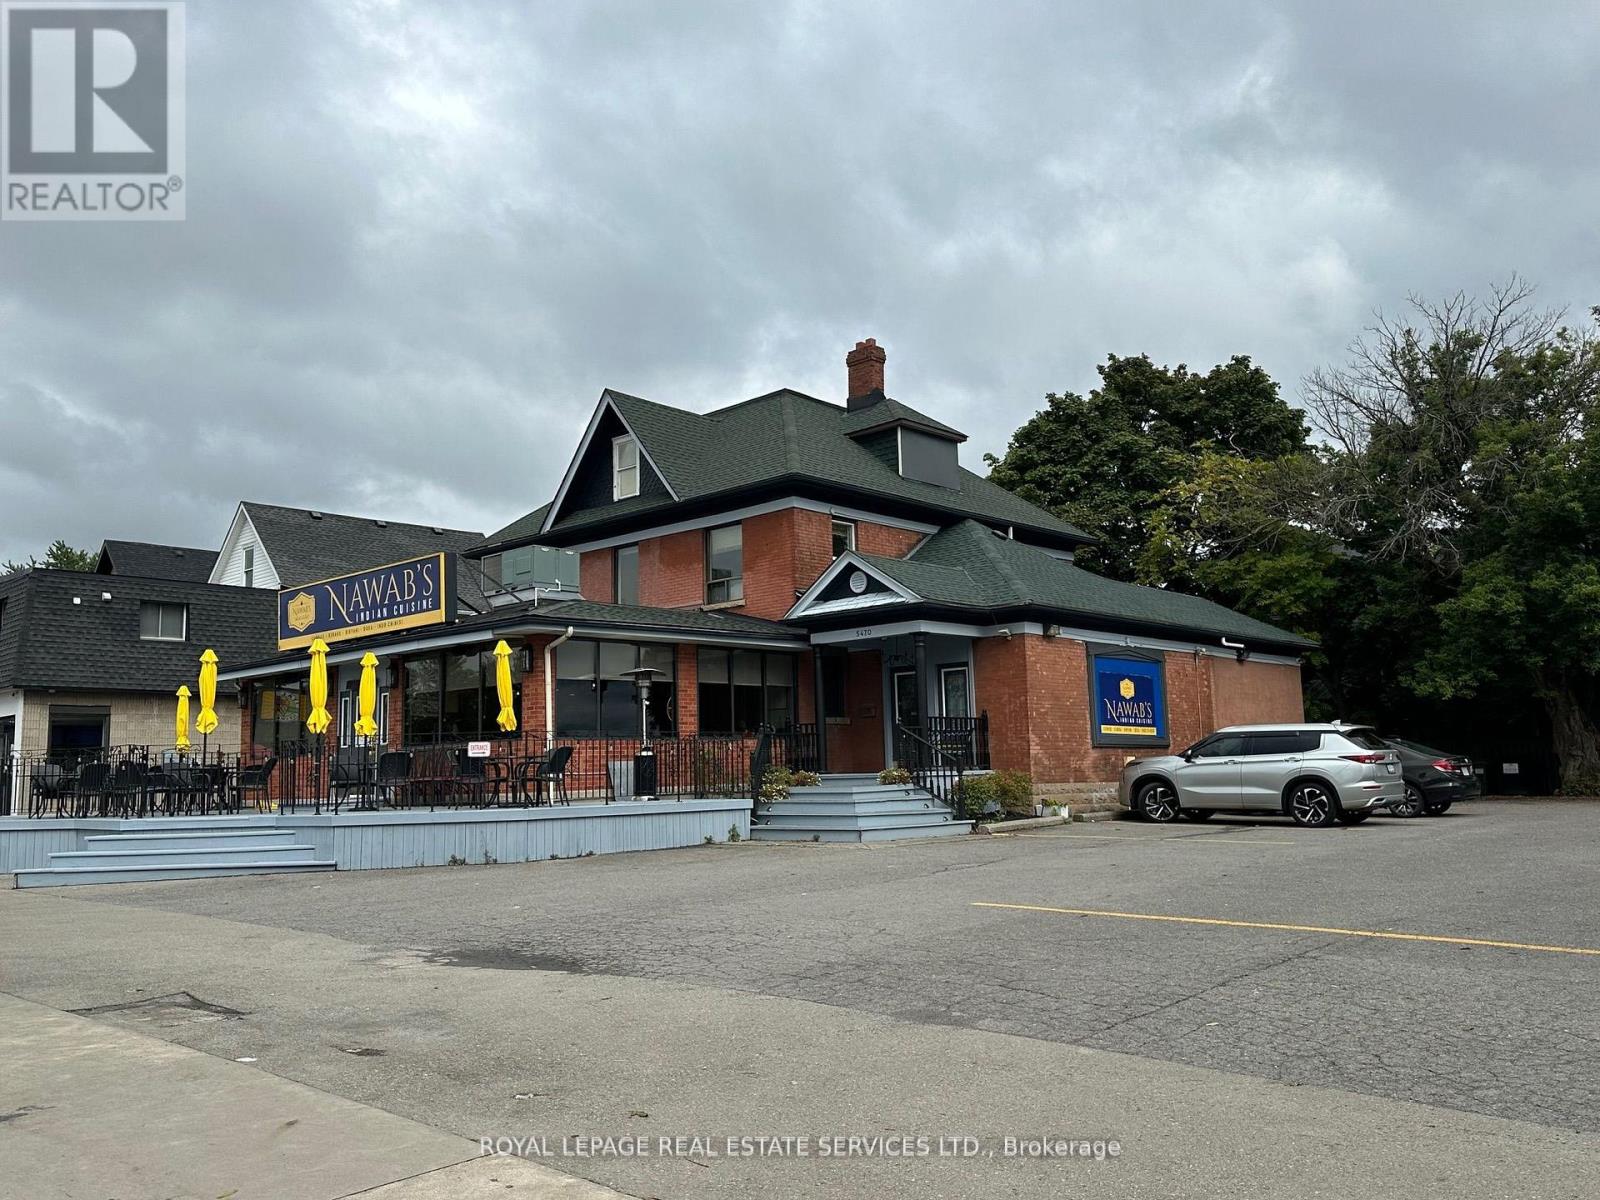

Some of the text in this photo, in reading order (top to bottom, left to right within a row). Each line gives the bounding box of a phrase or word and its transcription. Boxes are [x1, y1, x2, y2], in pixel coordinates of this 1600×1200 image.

[324, 564, 434, 623] NAWAB'S
[355, 598, 433, 623] INDIAN CUISINE
[856, 629, 872, 637] 5470
[1104, 698, 1153, 723] NAWAB'S
